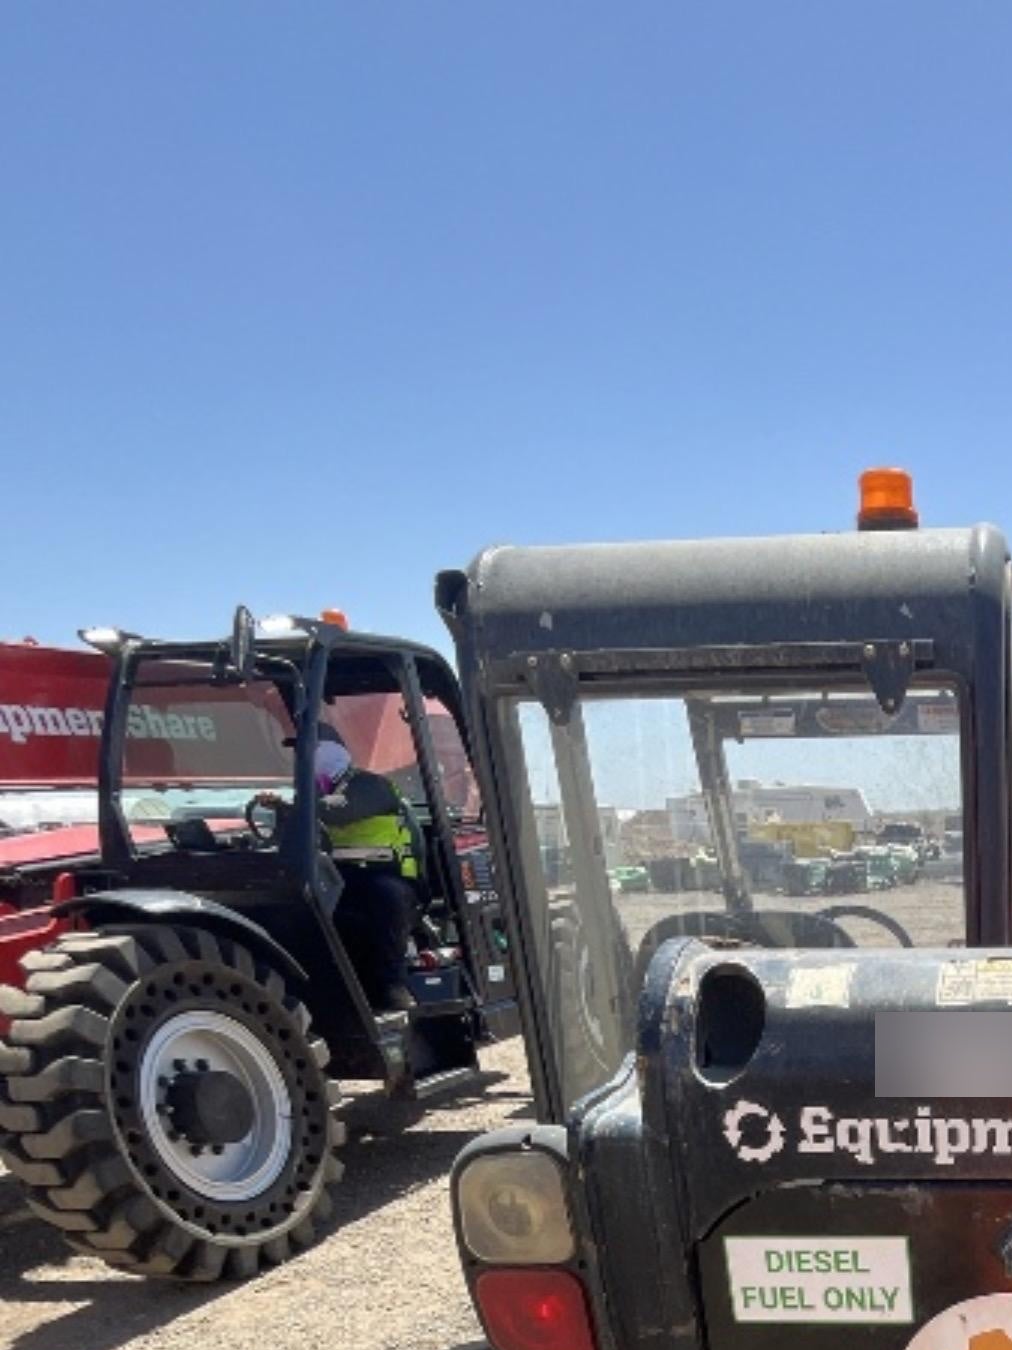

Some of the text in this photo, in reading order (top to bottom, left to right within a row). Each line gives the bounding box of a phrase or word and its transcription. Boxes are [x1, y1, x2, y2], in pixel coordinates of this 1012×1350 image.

[765, 1249, 871, 1274] DIESEL
[740, 1286, 900, 1312] FUEL ONLY
